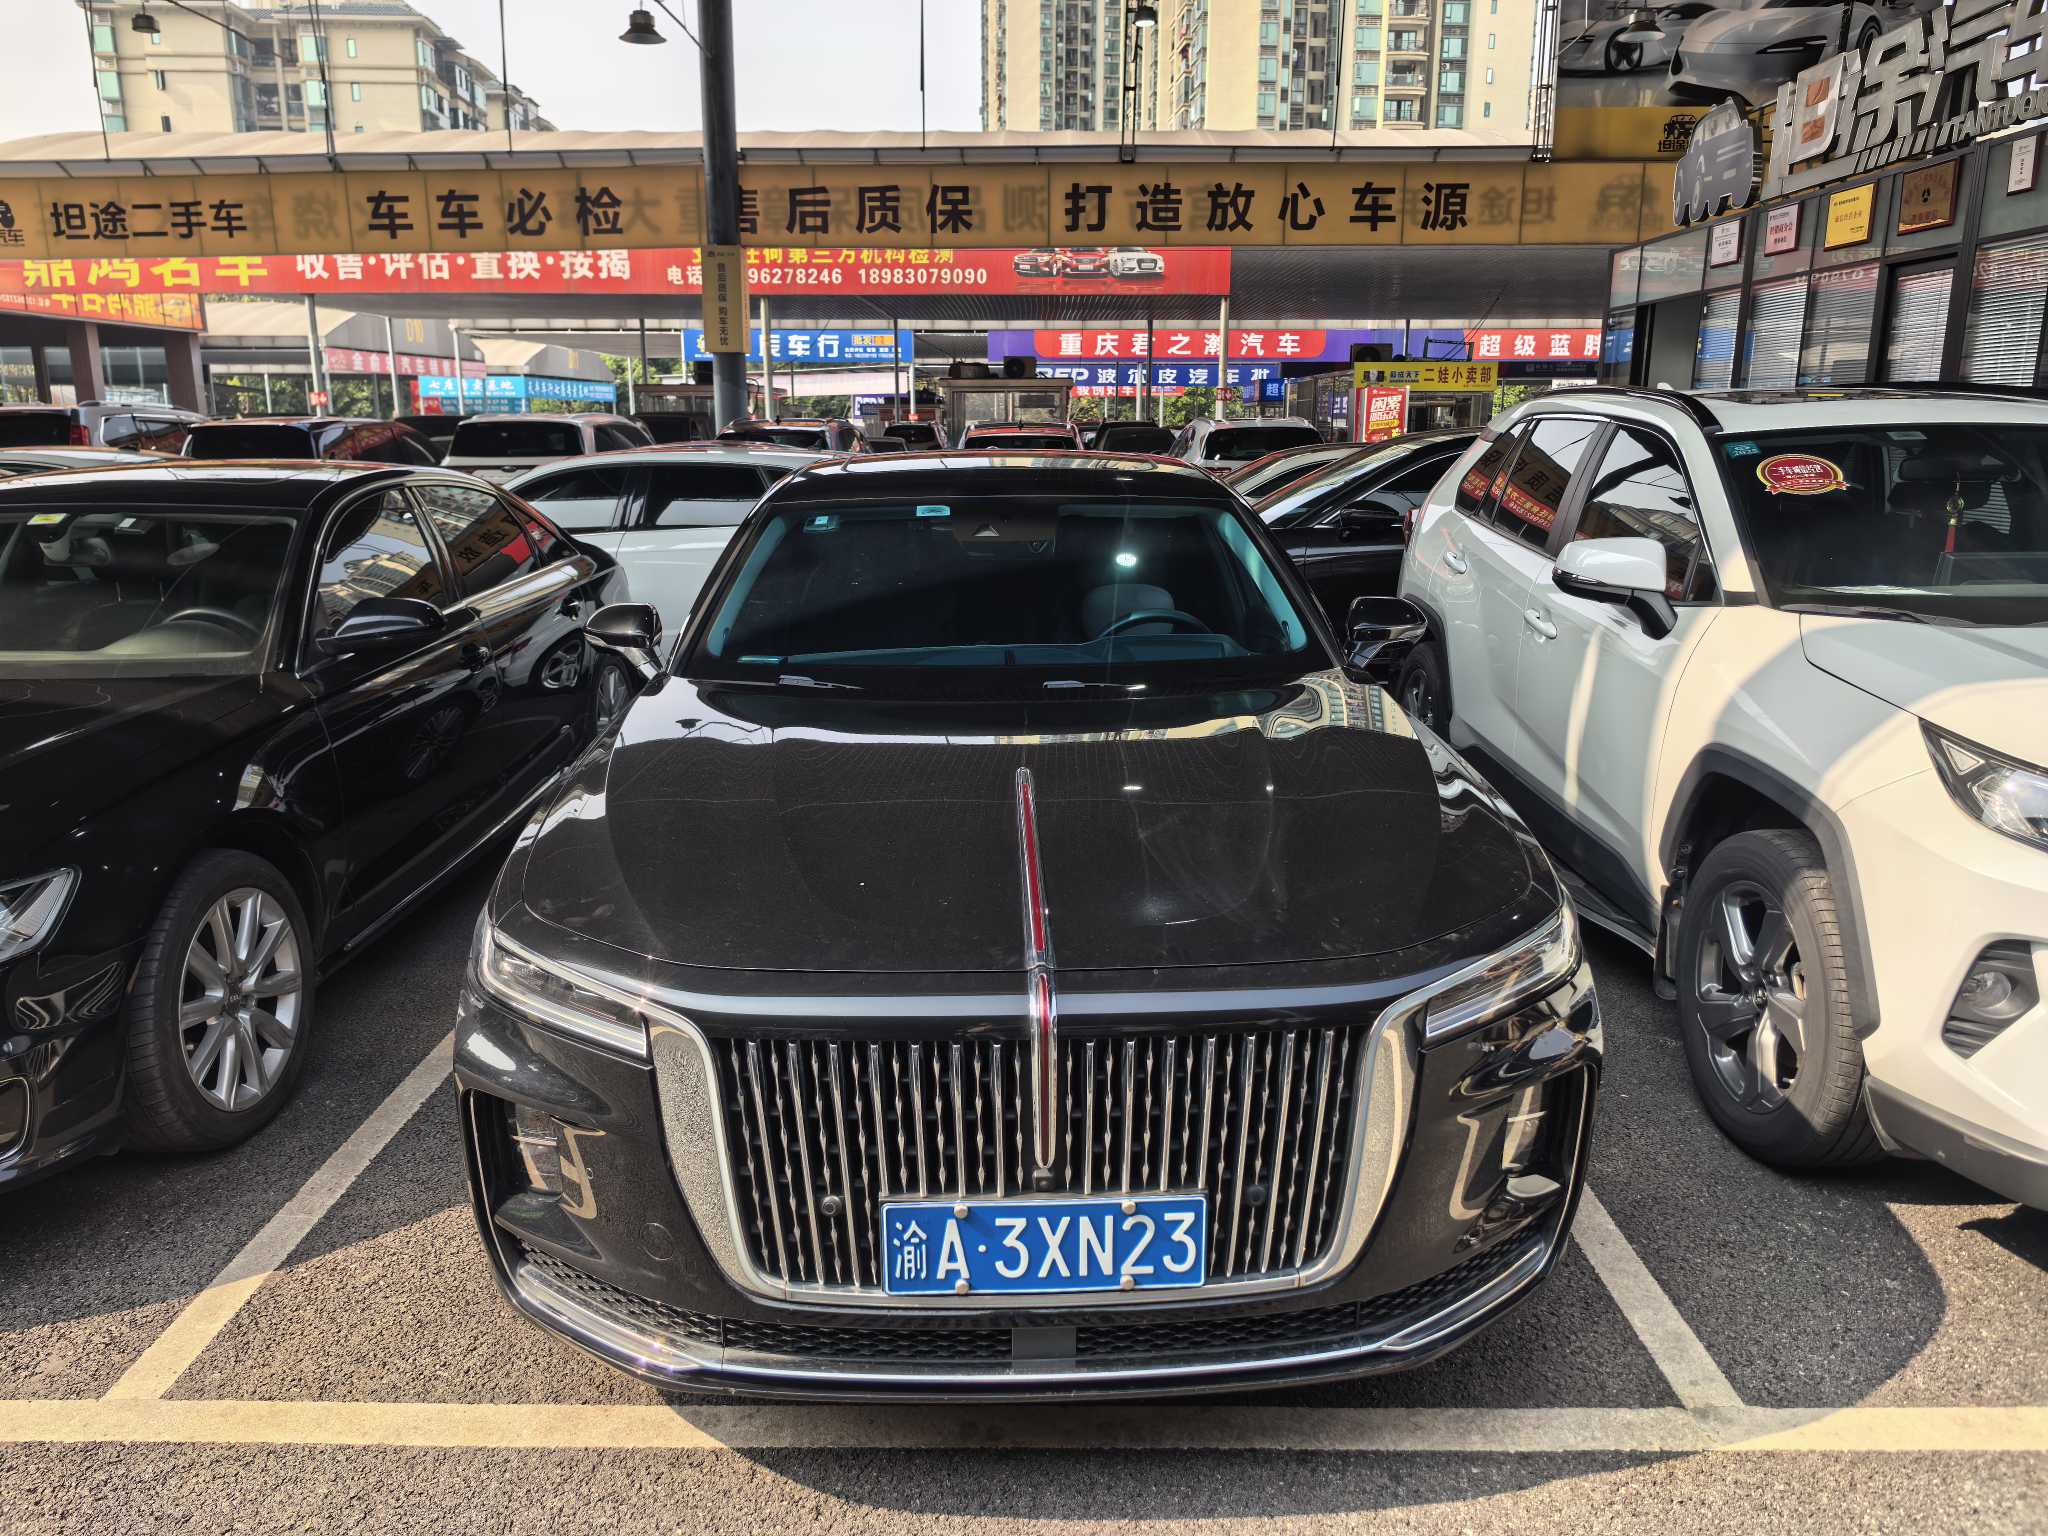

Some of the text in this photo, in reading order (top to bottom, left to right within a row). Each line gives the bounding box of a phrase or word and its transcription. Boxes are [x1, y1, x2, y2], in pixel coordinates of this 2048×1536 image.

[50, 199, 247, 240] 坦途二手车
[366, 188, 624, 240] 车车必检
[1064, 181, 1471, 233] 打造放心车源
[857, 266, 988, 285] 18983079090
[1423, 366, 1492, 384] 二娃小卖部
[893, 1211, 1197, 1281] 渝A·3XN23
